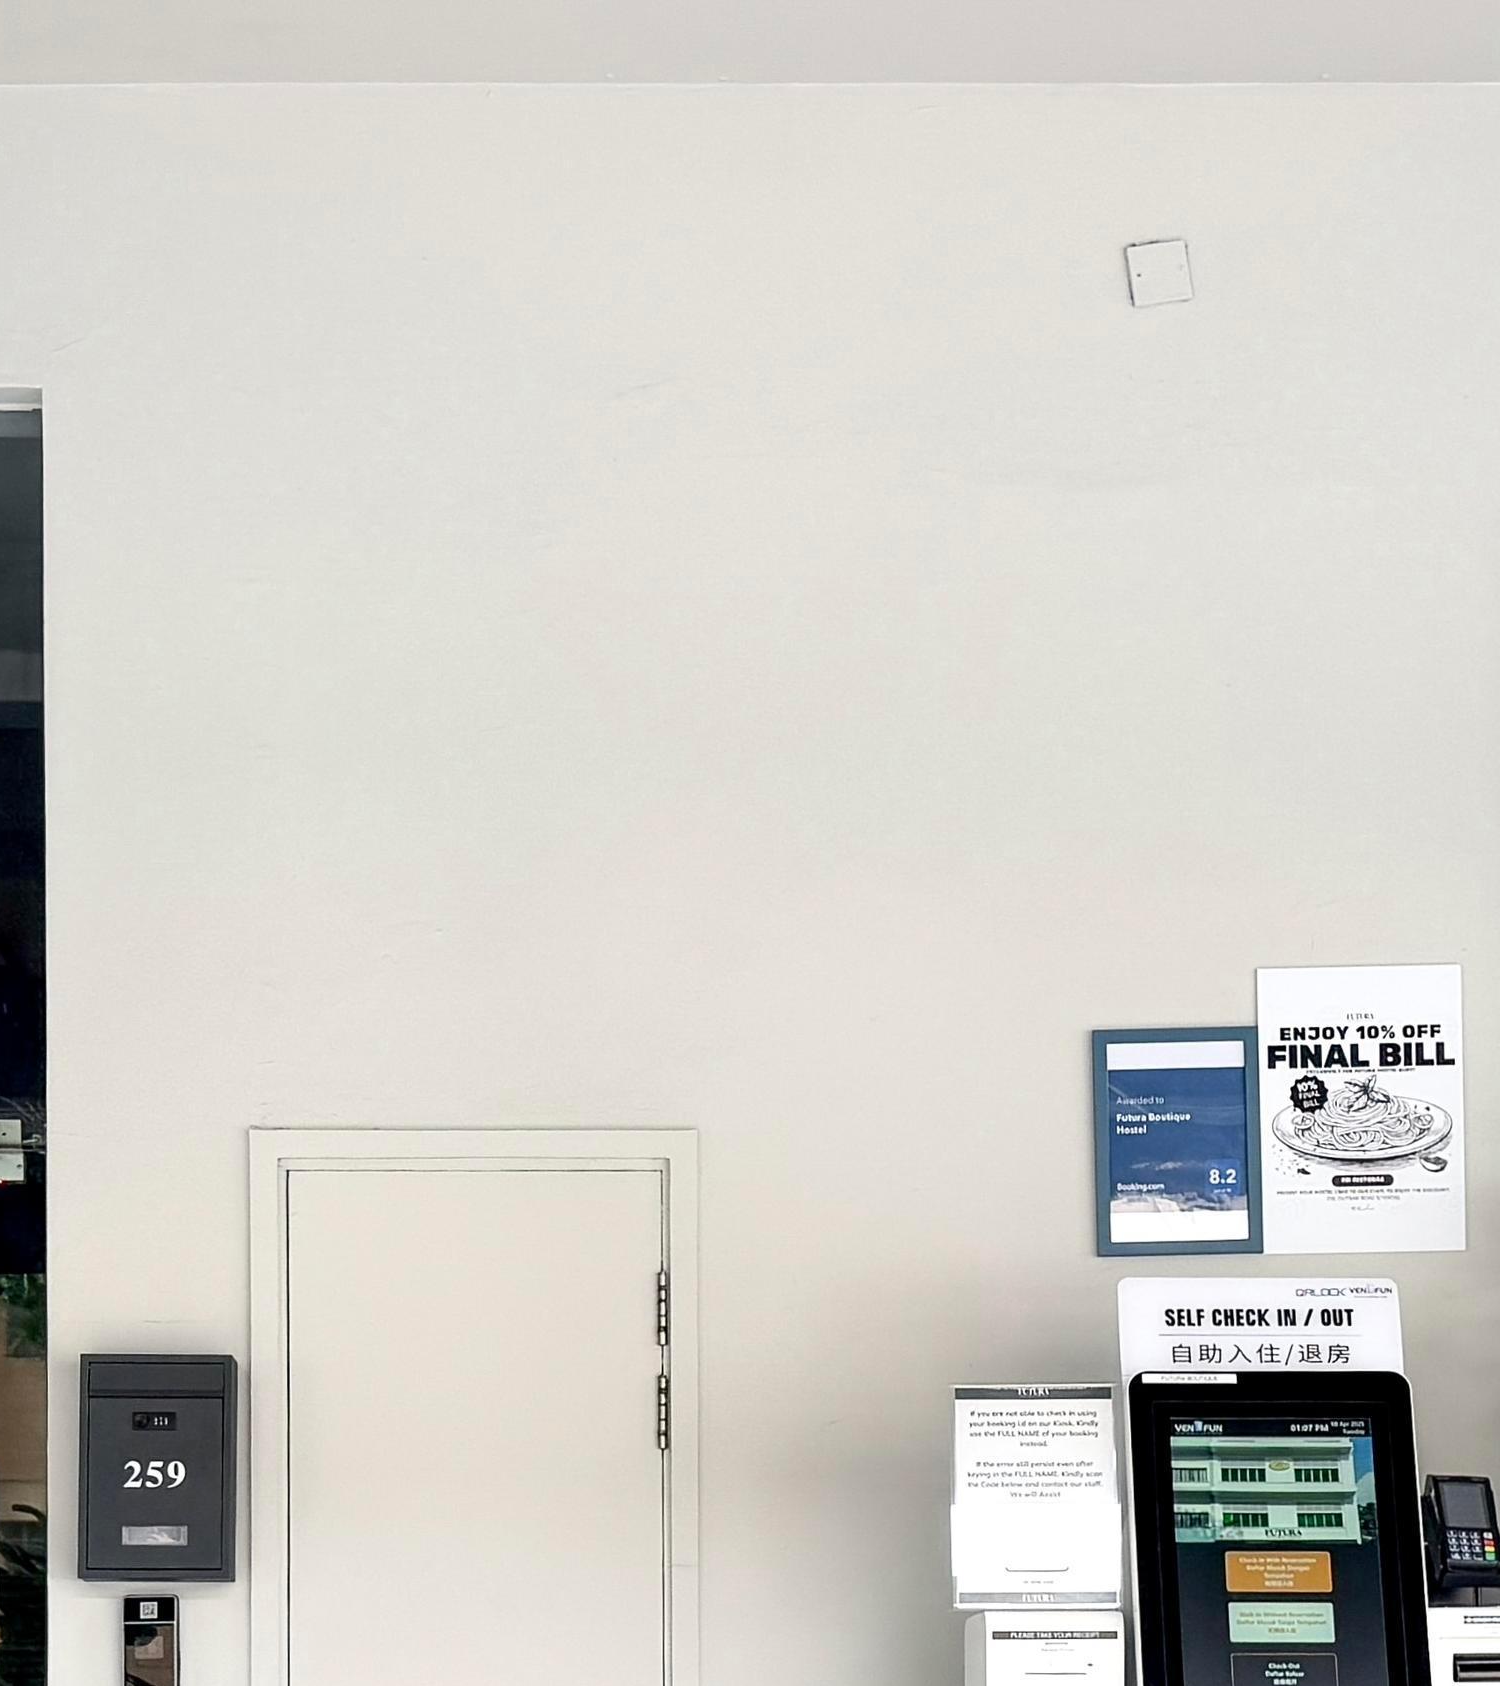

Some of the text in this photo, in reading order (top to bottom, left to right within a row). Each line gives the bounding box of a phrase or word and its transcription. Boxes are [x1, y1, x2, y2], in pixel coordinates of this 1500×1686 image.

[1280, 1024, 1441, 1041] ENJOY 10% OFF
[1267, 1042, 1455, 1069] FINAL BILL
[1116, 1112, 1191, 1123] Futura Boutique
[1116, 1125, 1147, 1135] Hostel
[1209, 1168, 1237, 1184] 8.2
[1164, 1308, 1205, 1327] SELF
[1211, 1308, 1271, 1327] CHECK
[1277, 1308, 1297, 1327] IN
[1320, 1308, 1355, 1327] OUT
[1171, 1343, 1351, 1366] 自助入住/退房
[123, 1459, 187, 1489] 259
